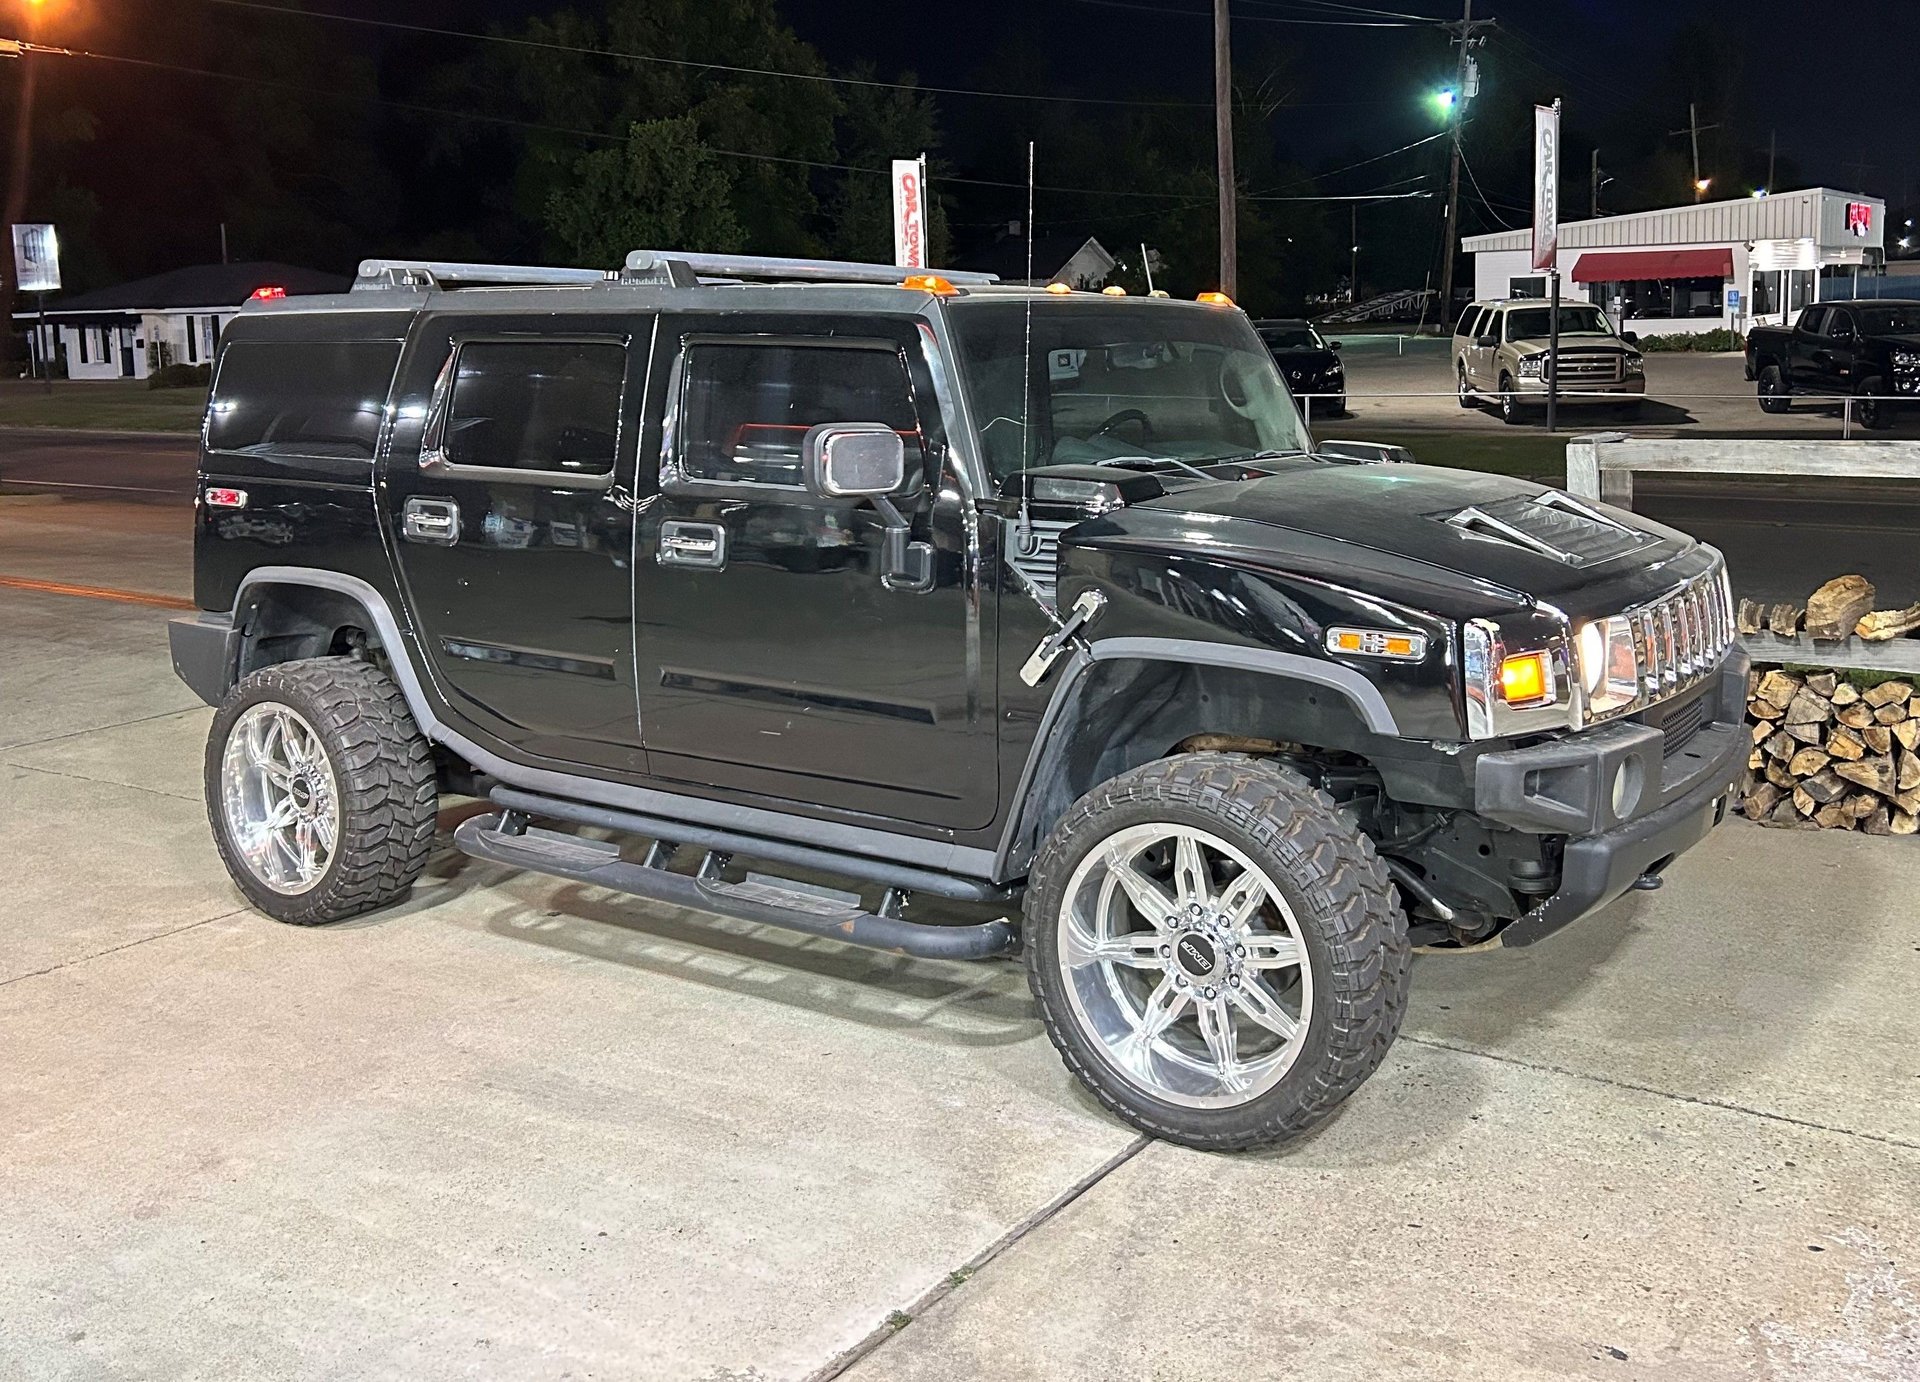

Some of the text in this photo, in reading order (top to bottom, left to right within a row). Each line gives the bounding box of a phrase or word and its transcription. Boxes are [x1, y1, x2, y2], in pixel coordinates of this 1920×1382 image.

[1542, 128, 1553, 183] CAR
[902, 173, 917, 222] CAR
[1180, 941, 1212, 971] BMF
